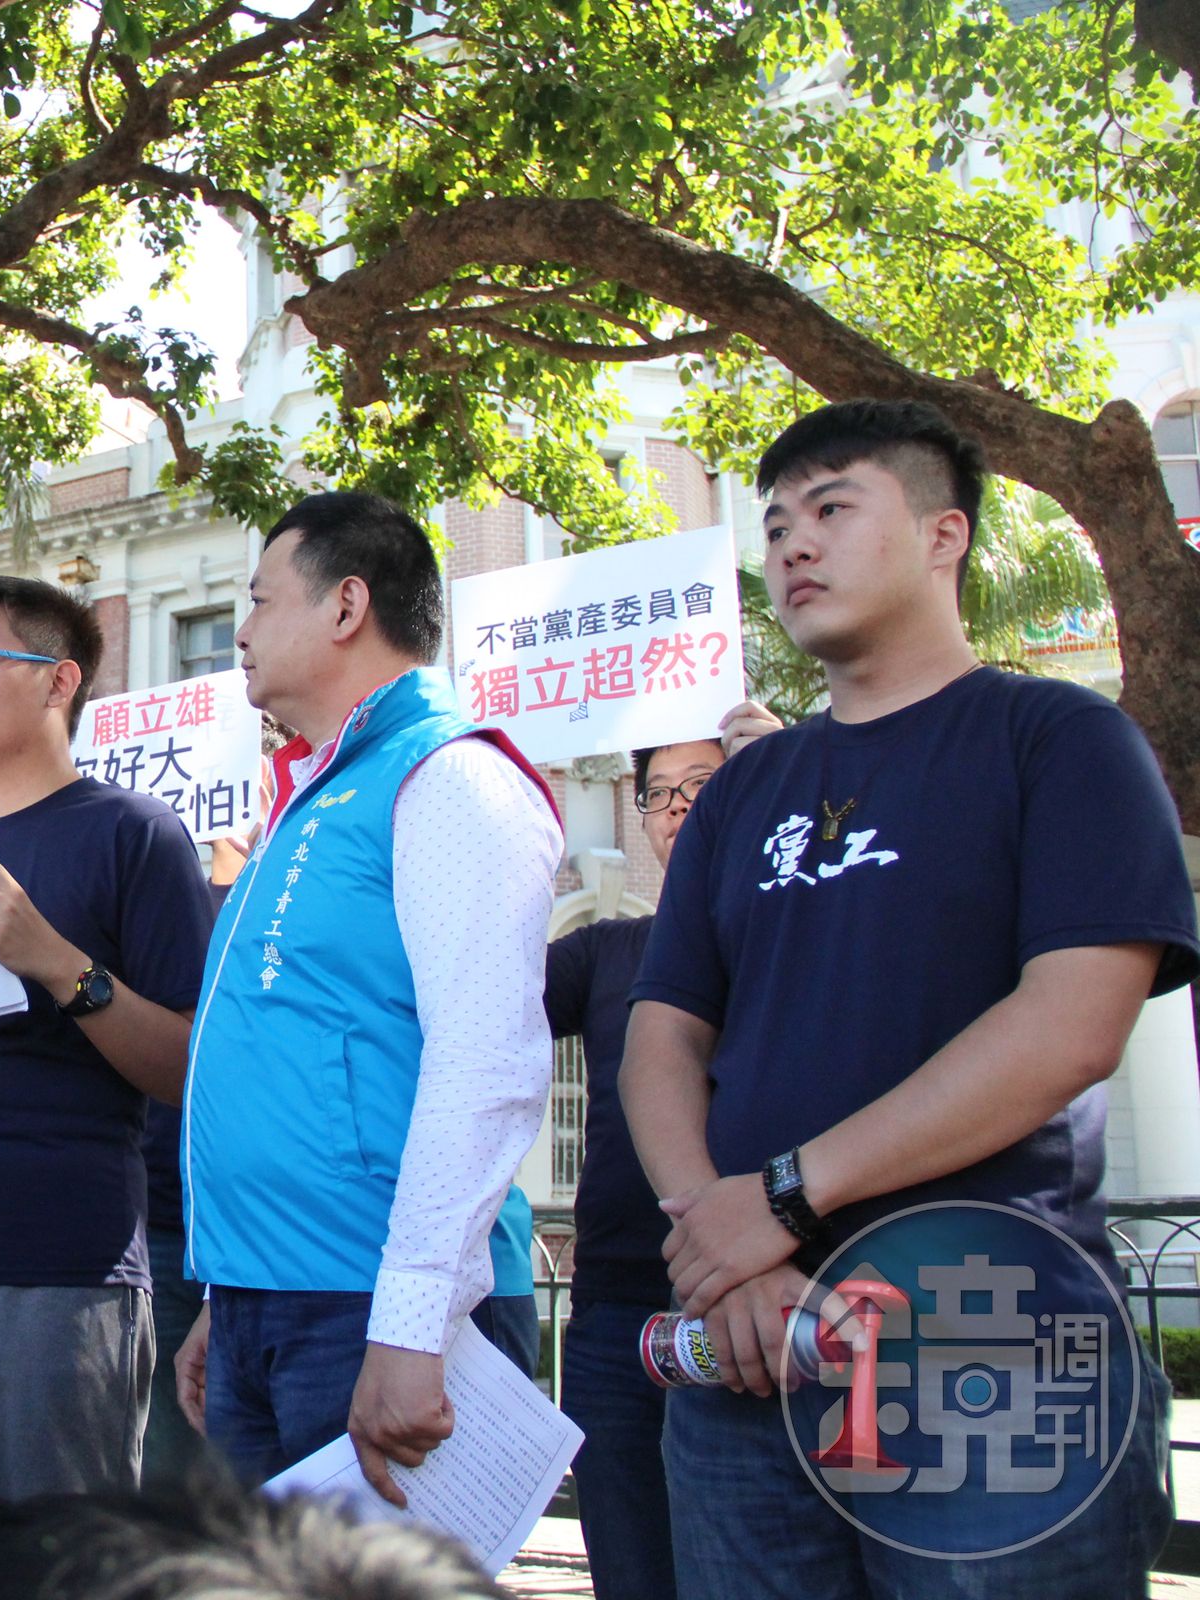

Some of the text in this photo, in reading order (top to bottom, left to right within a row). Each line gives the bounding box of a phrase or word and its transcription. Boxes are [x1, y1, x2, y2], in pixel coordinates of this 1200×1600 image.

[476, 582, 715, 655] 不當黨產委員會
[92, 682, 216, 747] 顧立雄
[759, 815, 899, 891] 黨工
[259, 816, 320, 990] 新北市青工總會
